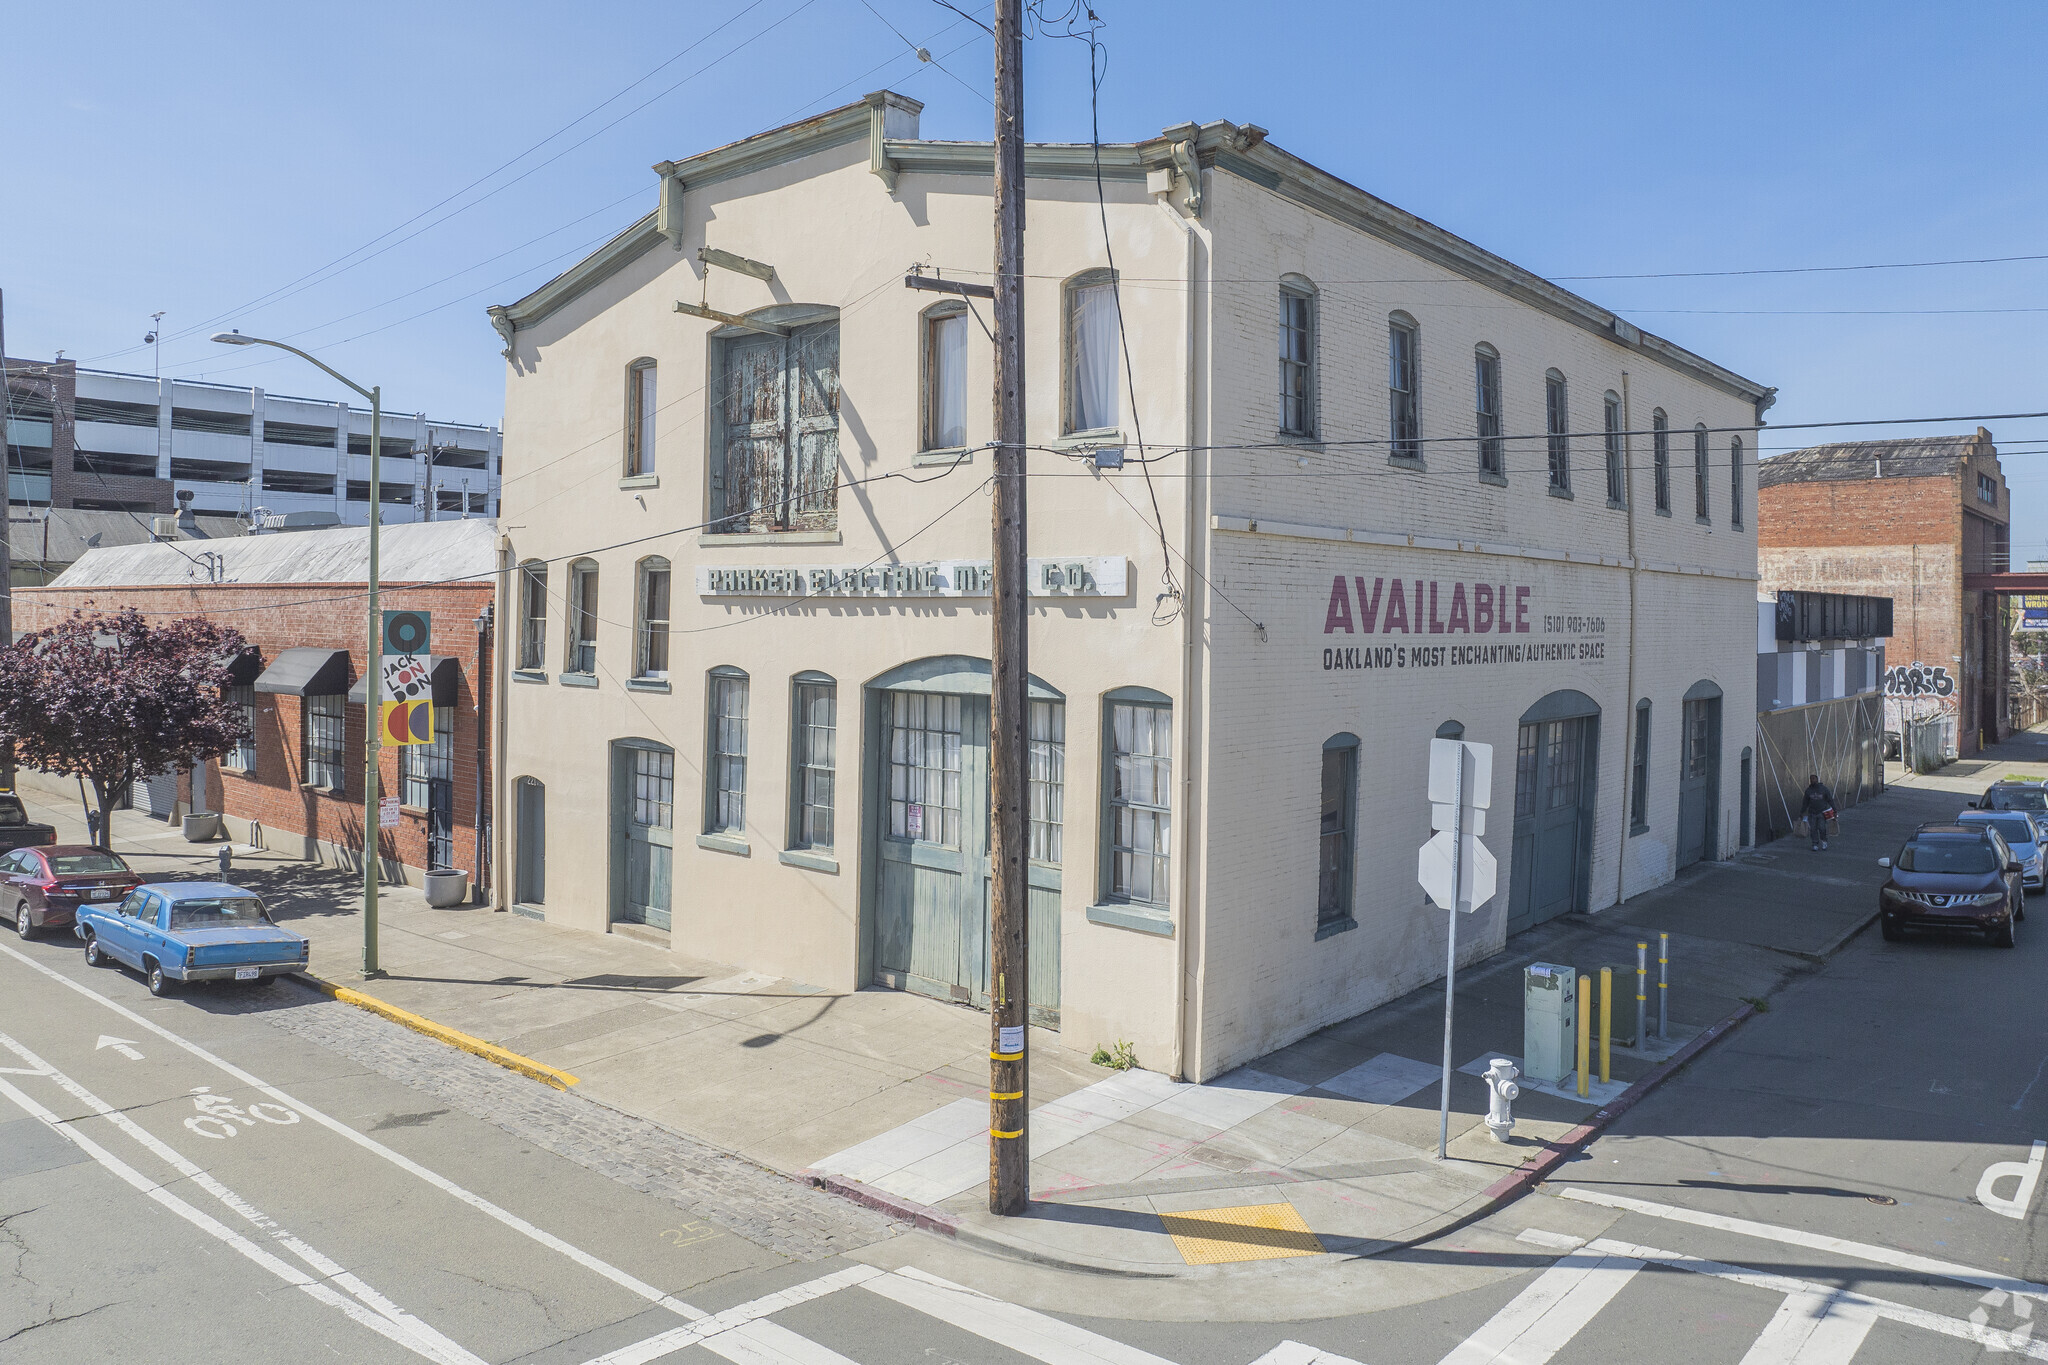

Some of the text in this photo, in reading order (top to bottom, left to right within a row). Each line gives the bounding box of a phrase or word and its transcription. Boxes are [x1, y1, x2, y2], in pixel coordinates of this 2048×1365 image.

[708, 563, 1094, 591] PARKER ELECTRIC MF CO.
[1323, 575, 1531, 634] AVAILABLE
[1543, 615, 1606, 634] (510) 903-7606
[383, 652, 417, 679] JACK
[1323, 643, 1605, 670] OAKLAND'S MOST ENCHANTING/AUTHENTIC SPACE
[659, 1220, 715, 1245] 25
